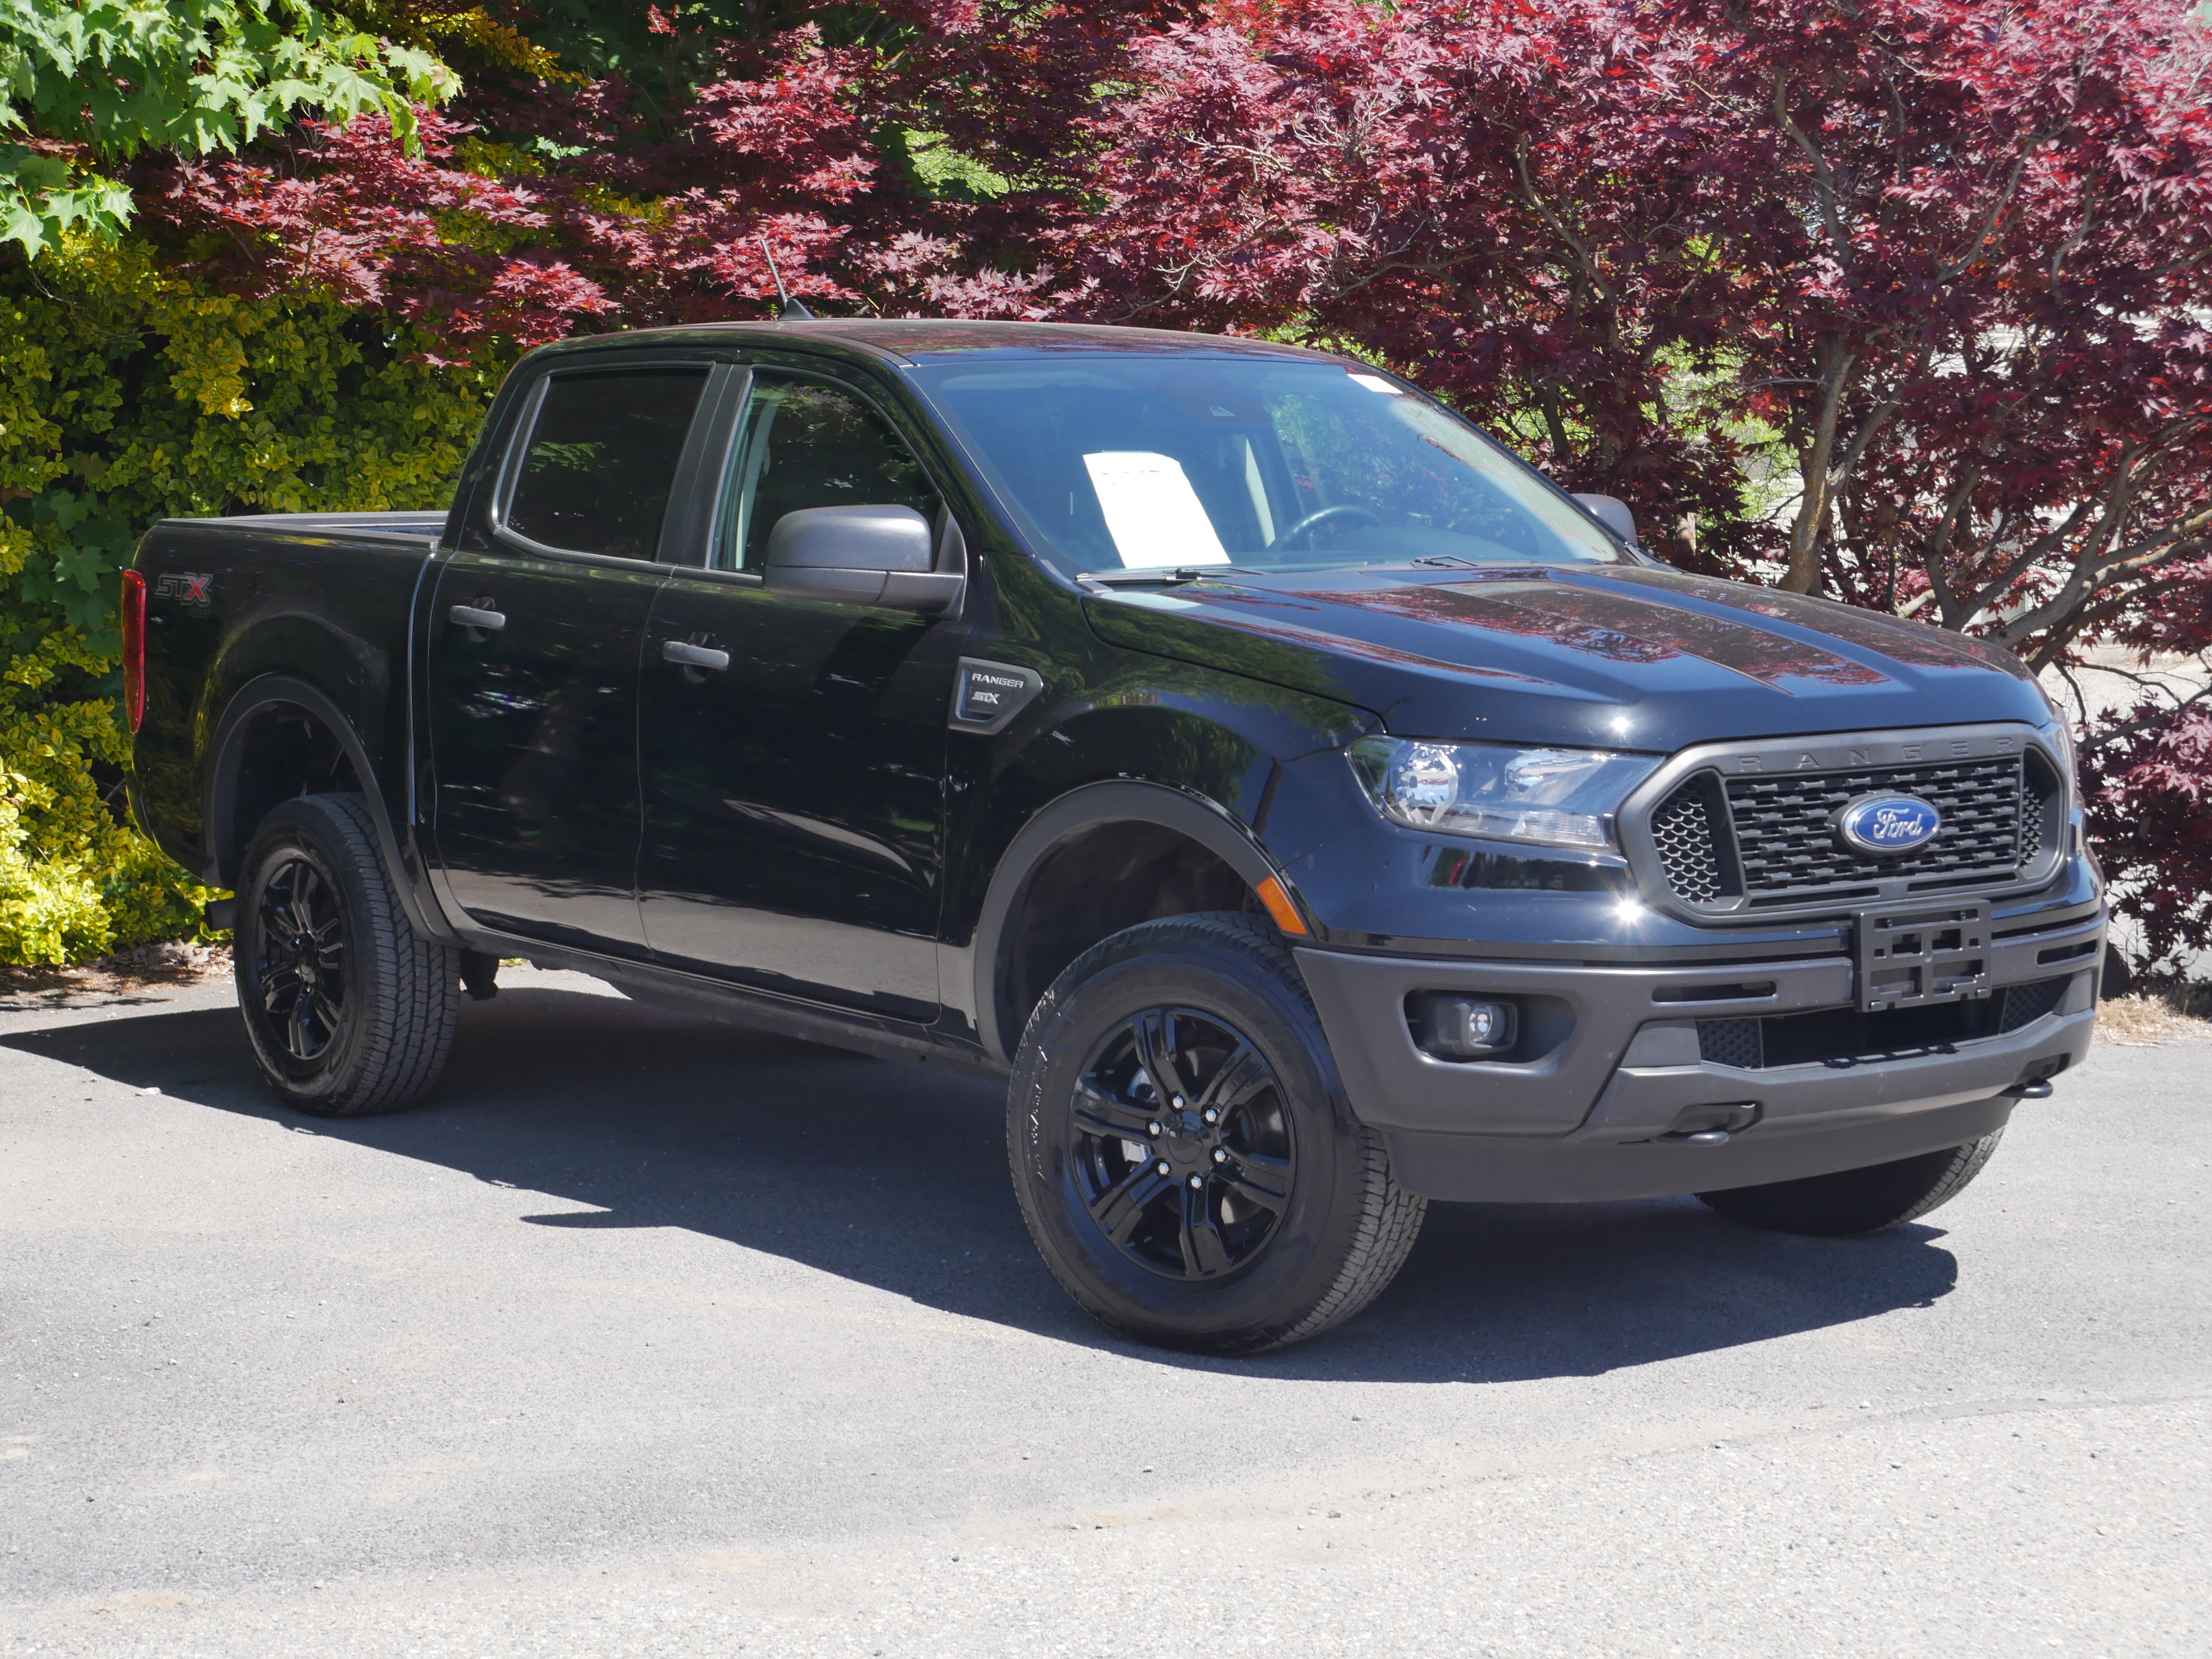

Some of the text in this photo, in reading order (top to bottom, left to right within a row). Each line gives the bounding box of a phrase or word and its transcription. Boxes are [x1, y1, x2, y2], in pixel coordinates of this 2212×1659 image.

[154, 571, 214, 608] STX
[972, 673, 1024, 689] RANGER
[972, 691, 1000, 704] STX
[1738, 737, 2014, 771] RANGER
[1873, 808, 1922, 839] Ford
